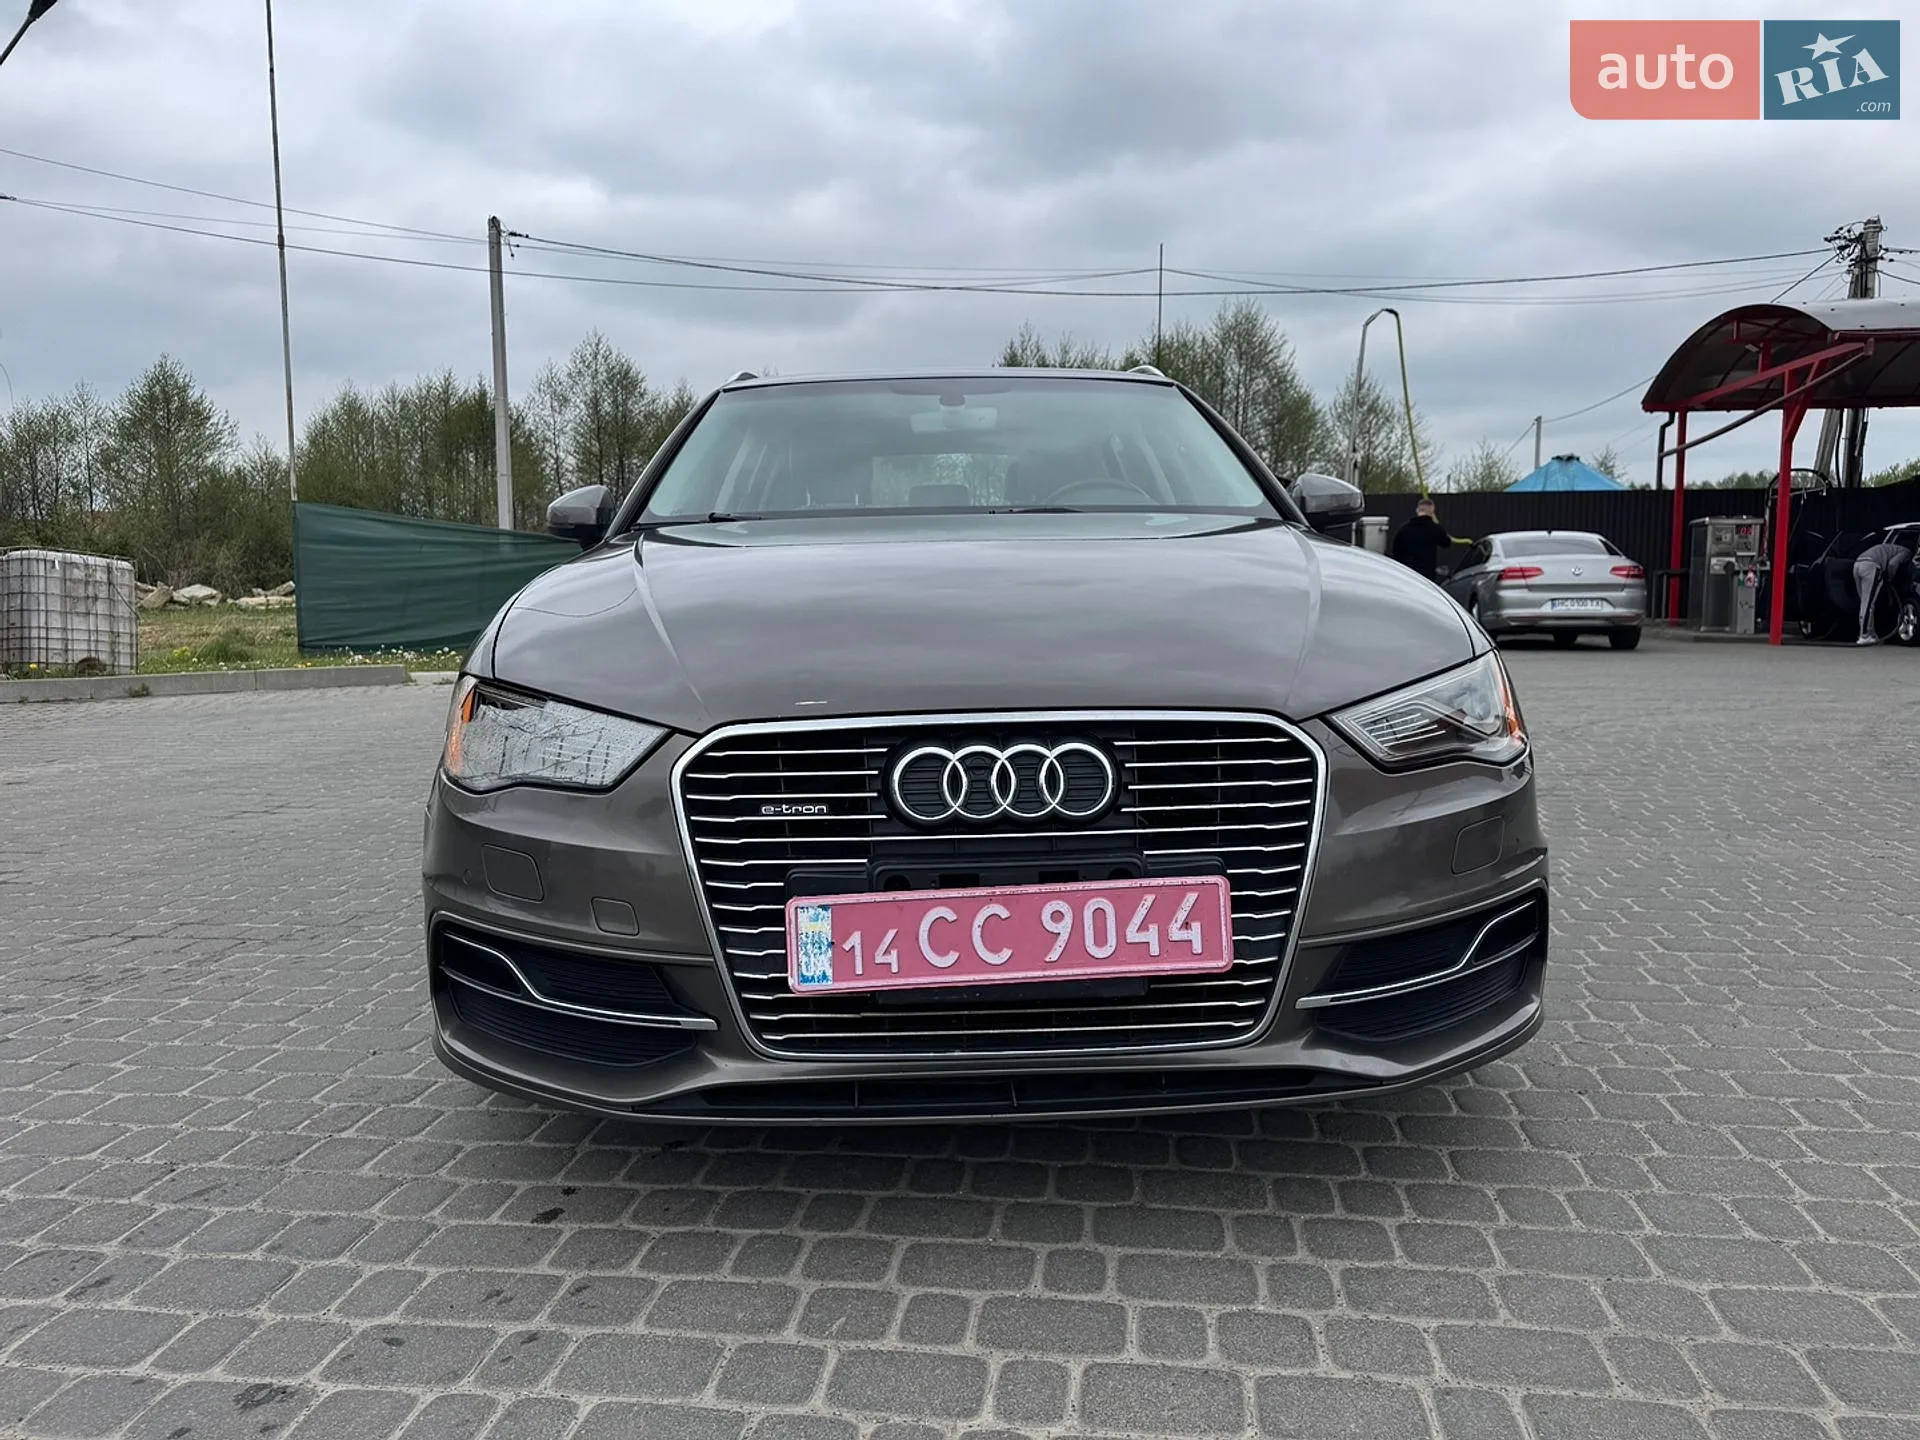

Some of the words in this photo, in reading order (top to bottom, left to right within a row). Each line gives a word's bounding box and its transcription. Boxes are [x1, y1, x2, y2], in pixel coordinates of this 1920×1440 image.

[761, 804, 827, 815] e-tron
[841, 928, 899, 975] 14
[918, 903, 1013, 968] CC
[1041, 892, 1202, 962] 9044
